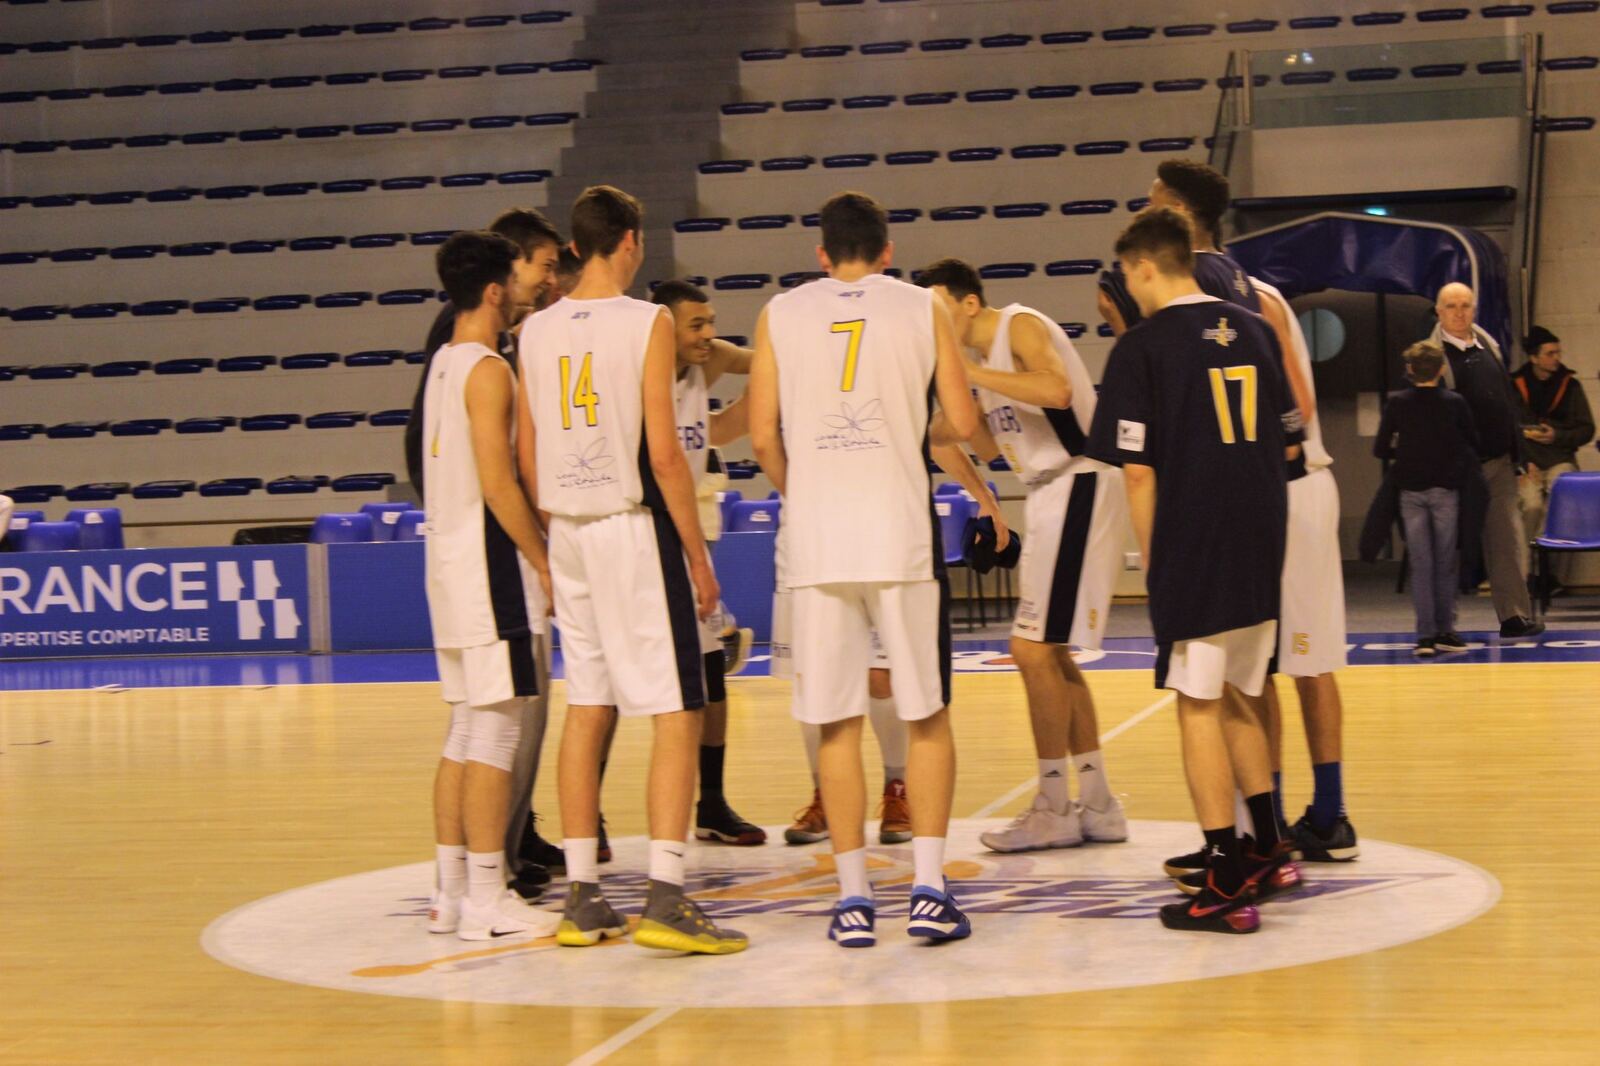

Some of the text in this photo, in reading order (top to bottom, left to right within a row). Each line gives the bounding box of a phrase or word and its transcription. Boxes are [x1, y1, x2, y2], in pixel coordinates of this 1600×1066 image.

[559, 352, 598, 430] 14
[830, 318, 866, 392] 7
[1208, 365, 1257, 444] 17
[0, 627, 210, 647] PERTISE COMPTABLE
